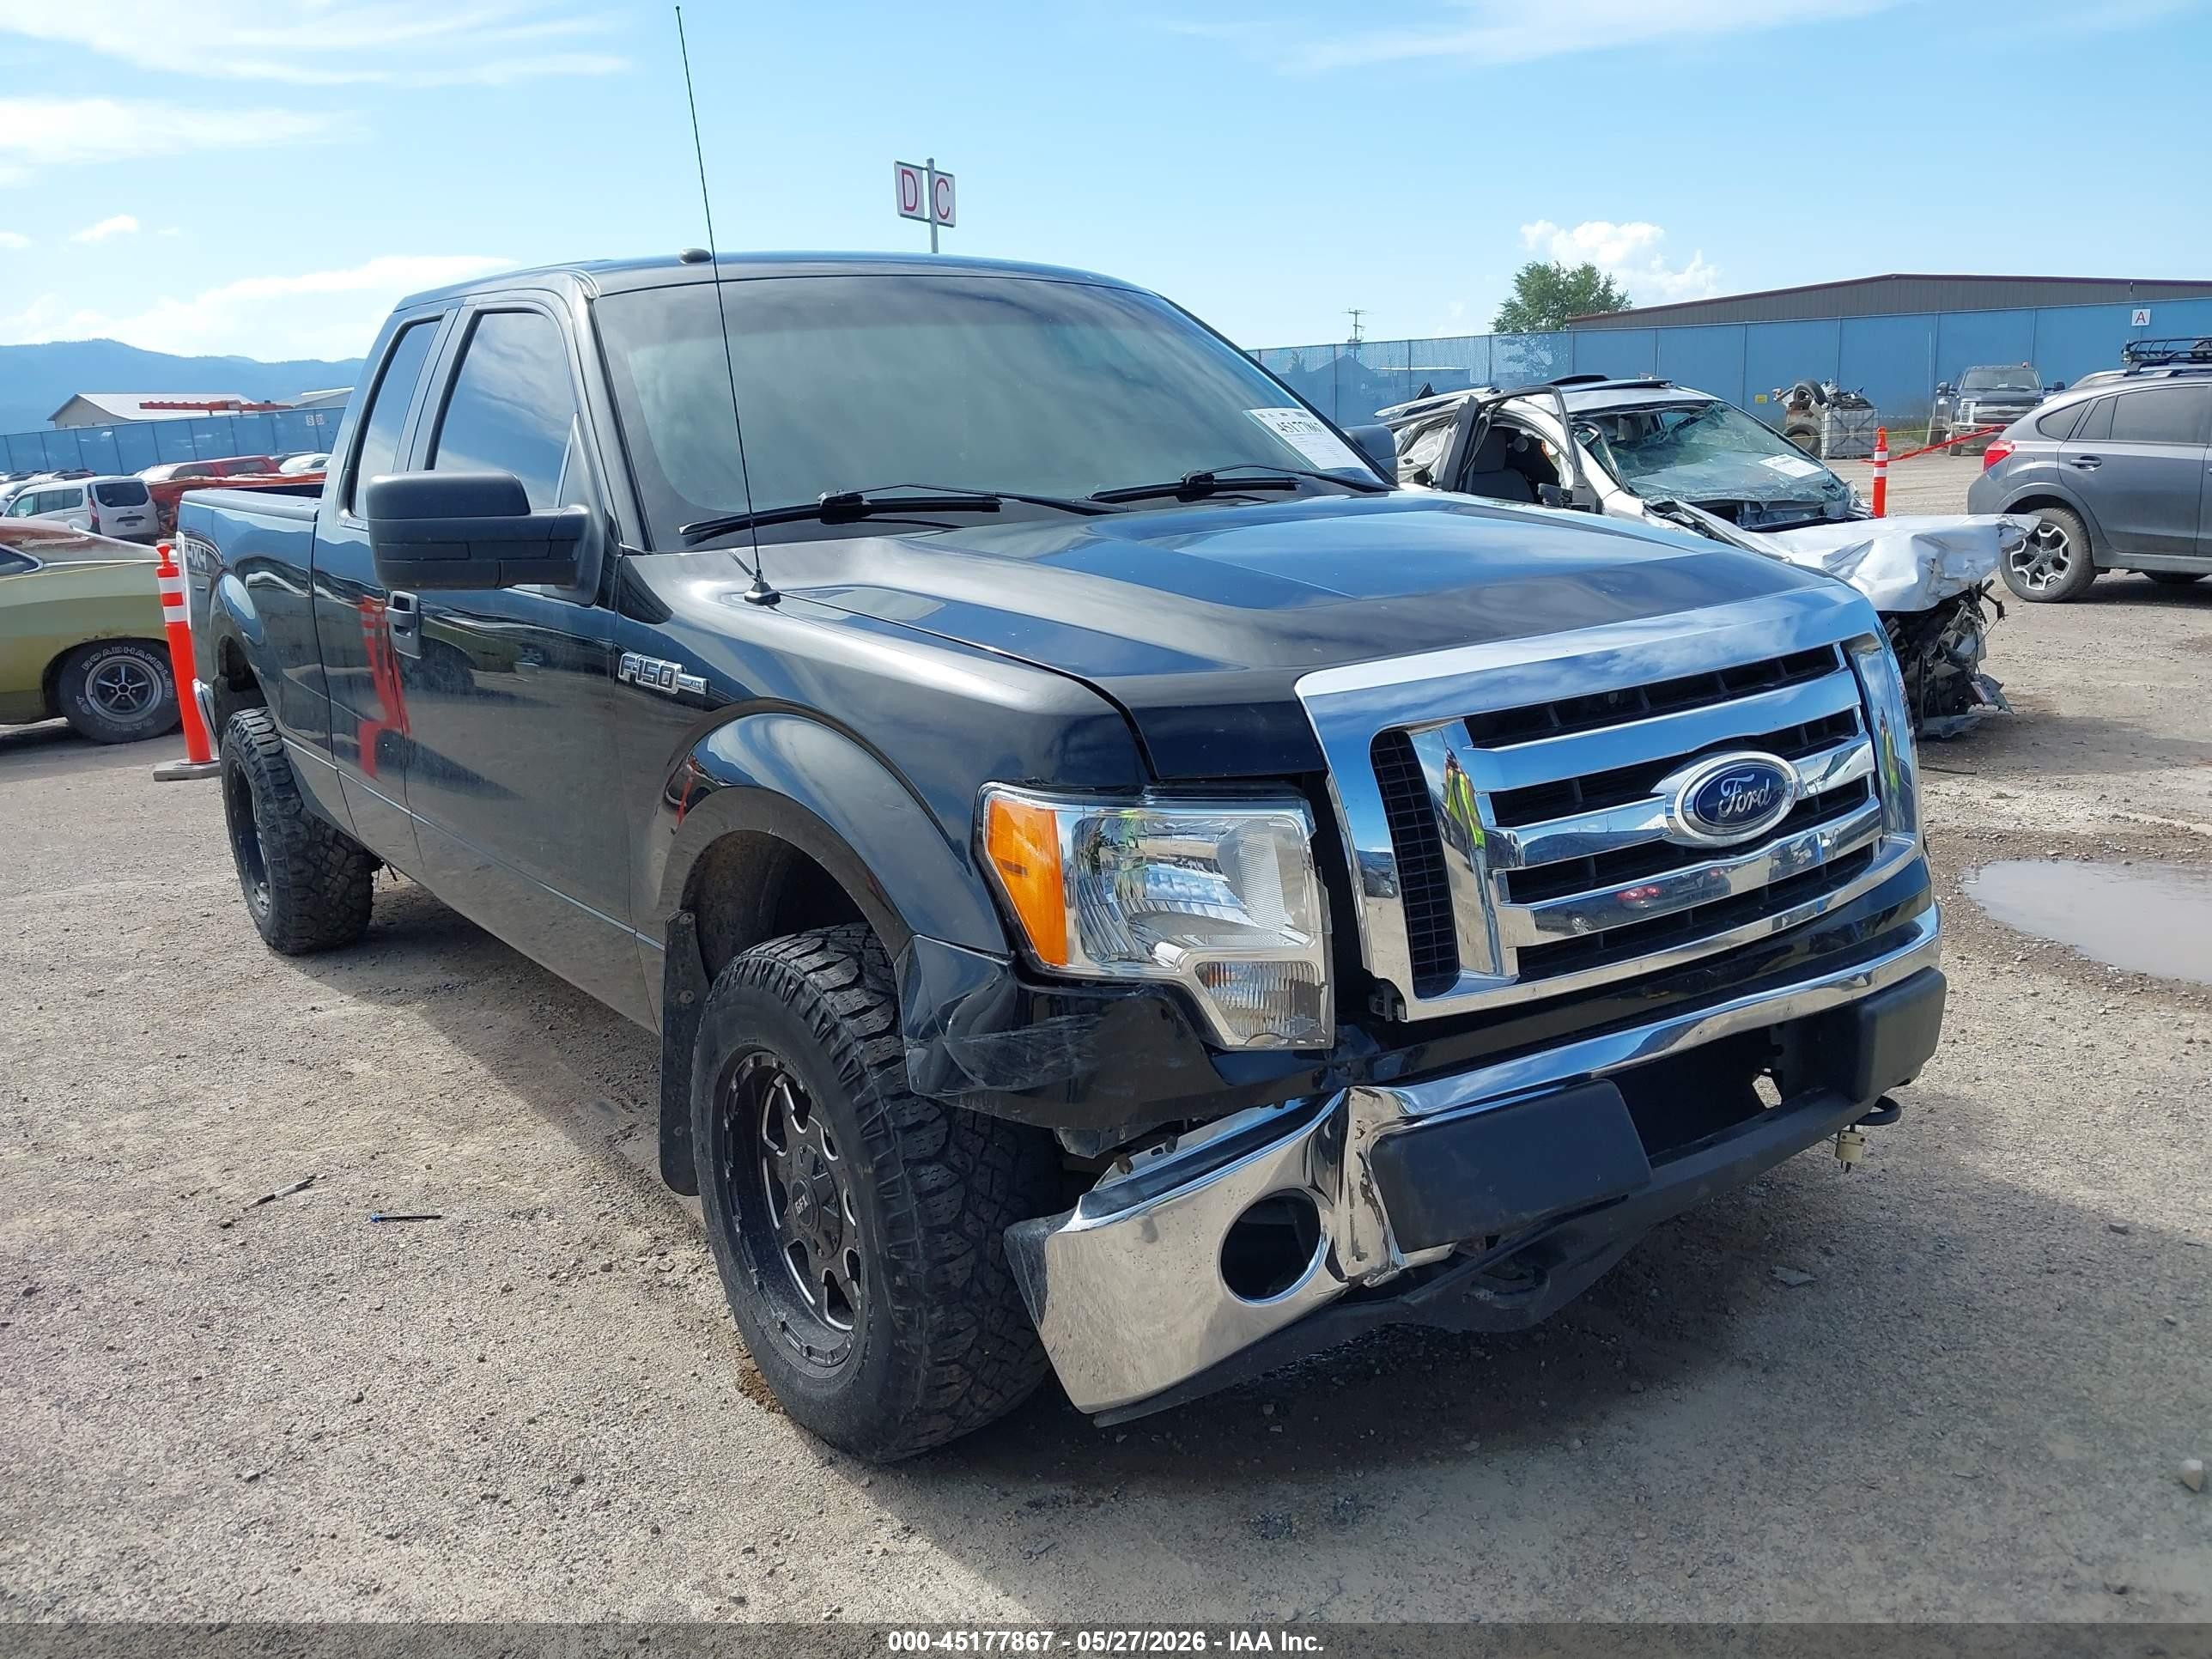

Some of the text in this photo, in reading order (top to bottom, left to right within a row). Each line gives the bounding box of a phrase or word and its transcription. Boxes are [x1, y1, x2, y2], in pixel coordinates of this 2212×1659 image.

[902, 168, 918, 212] D
[935, 178, 950, 220] C
[2135, 311, 2146, 324] A
[1276, 420, 1327, 434] 45177867
[1718, 774, 1771, 817] Ford
[794, 1193, 808, 1215] GFX
